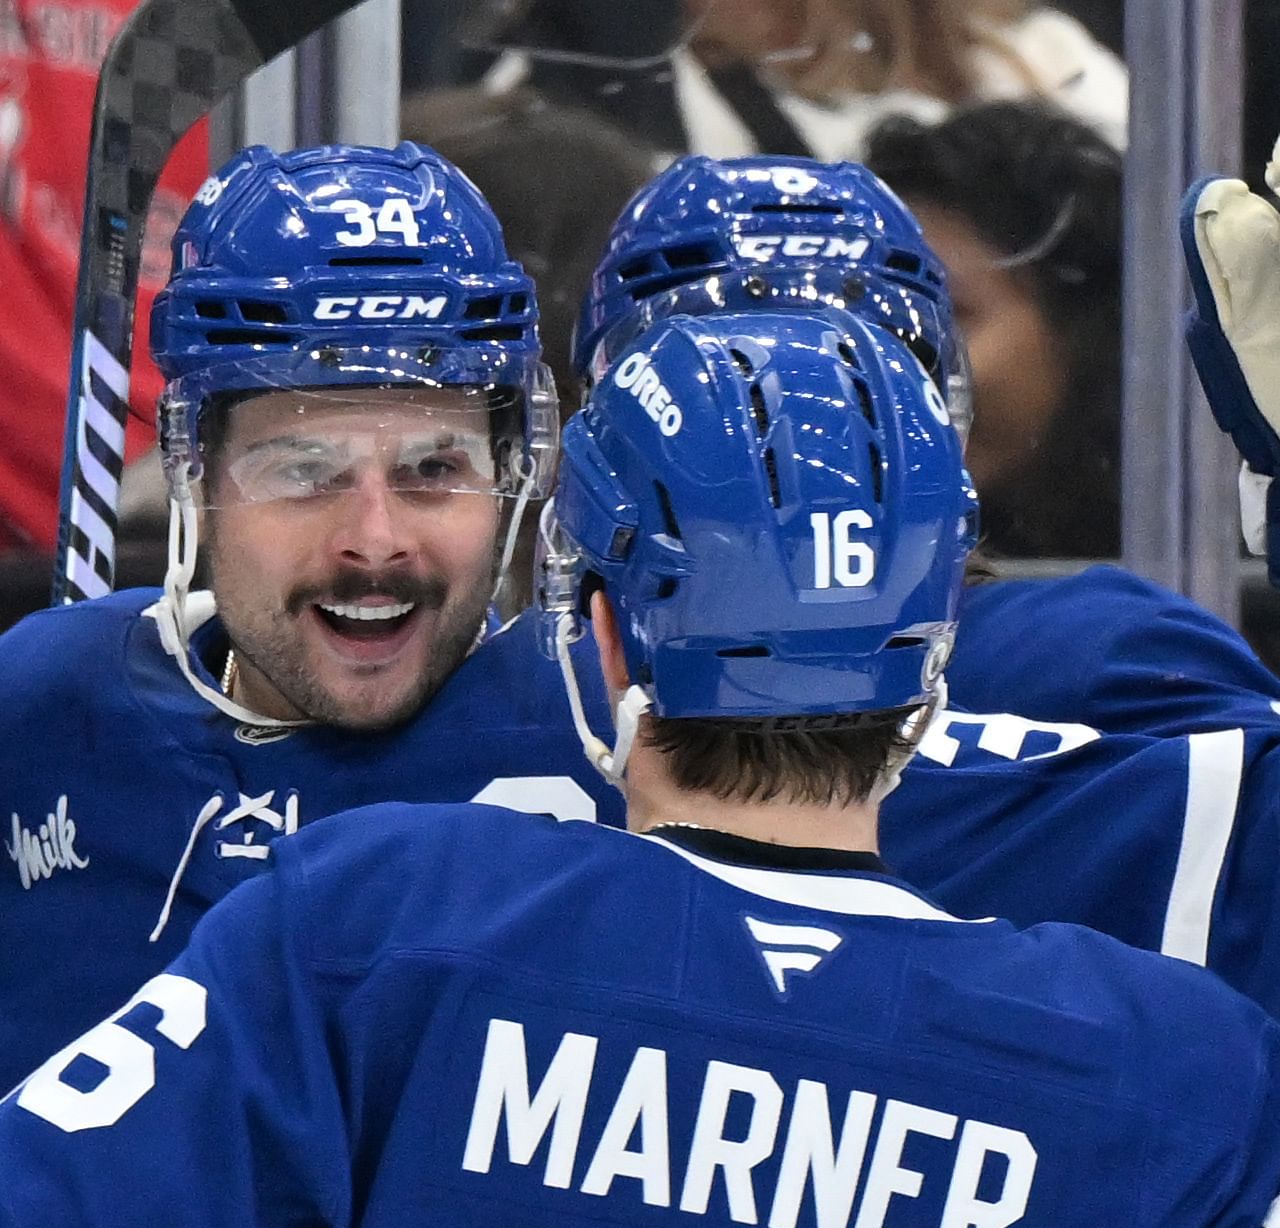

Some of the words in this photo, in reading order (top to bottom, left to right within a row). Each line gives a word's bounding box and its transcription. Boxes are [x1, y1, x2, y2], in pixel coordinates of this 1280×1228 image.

[330, 199, 419, 247] 34
[737, 234, 871, 262] CCM
[313, 296, 447, 320] CCM
[614, 351, 683, 437] OREO
[810, 509, 875, 589] 16
